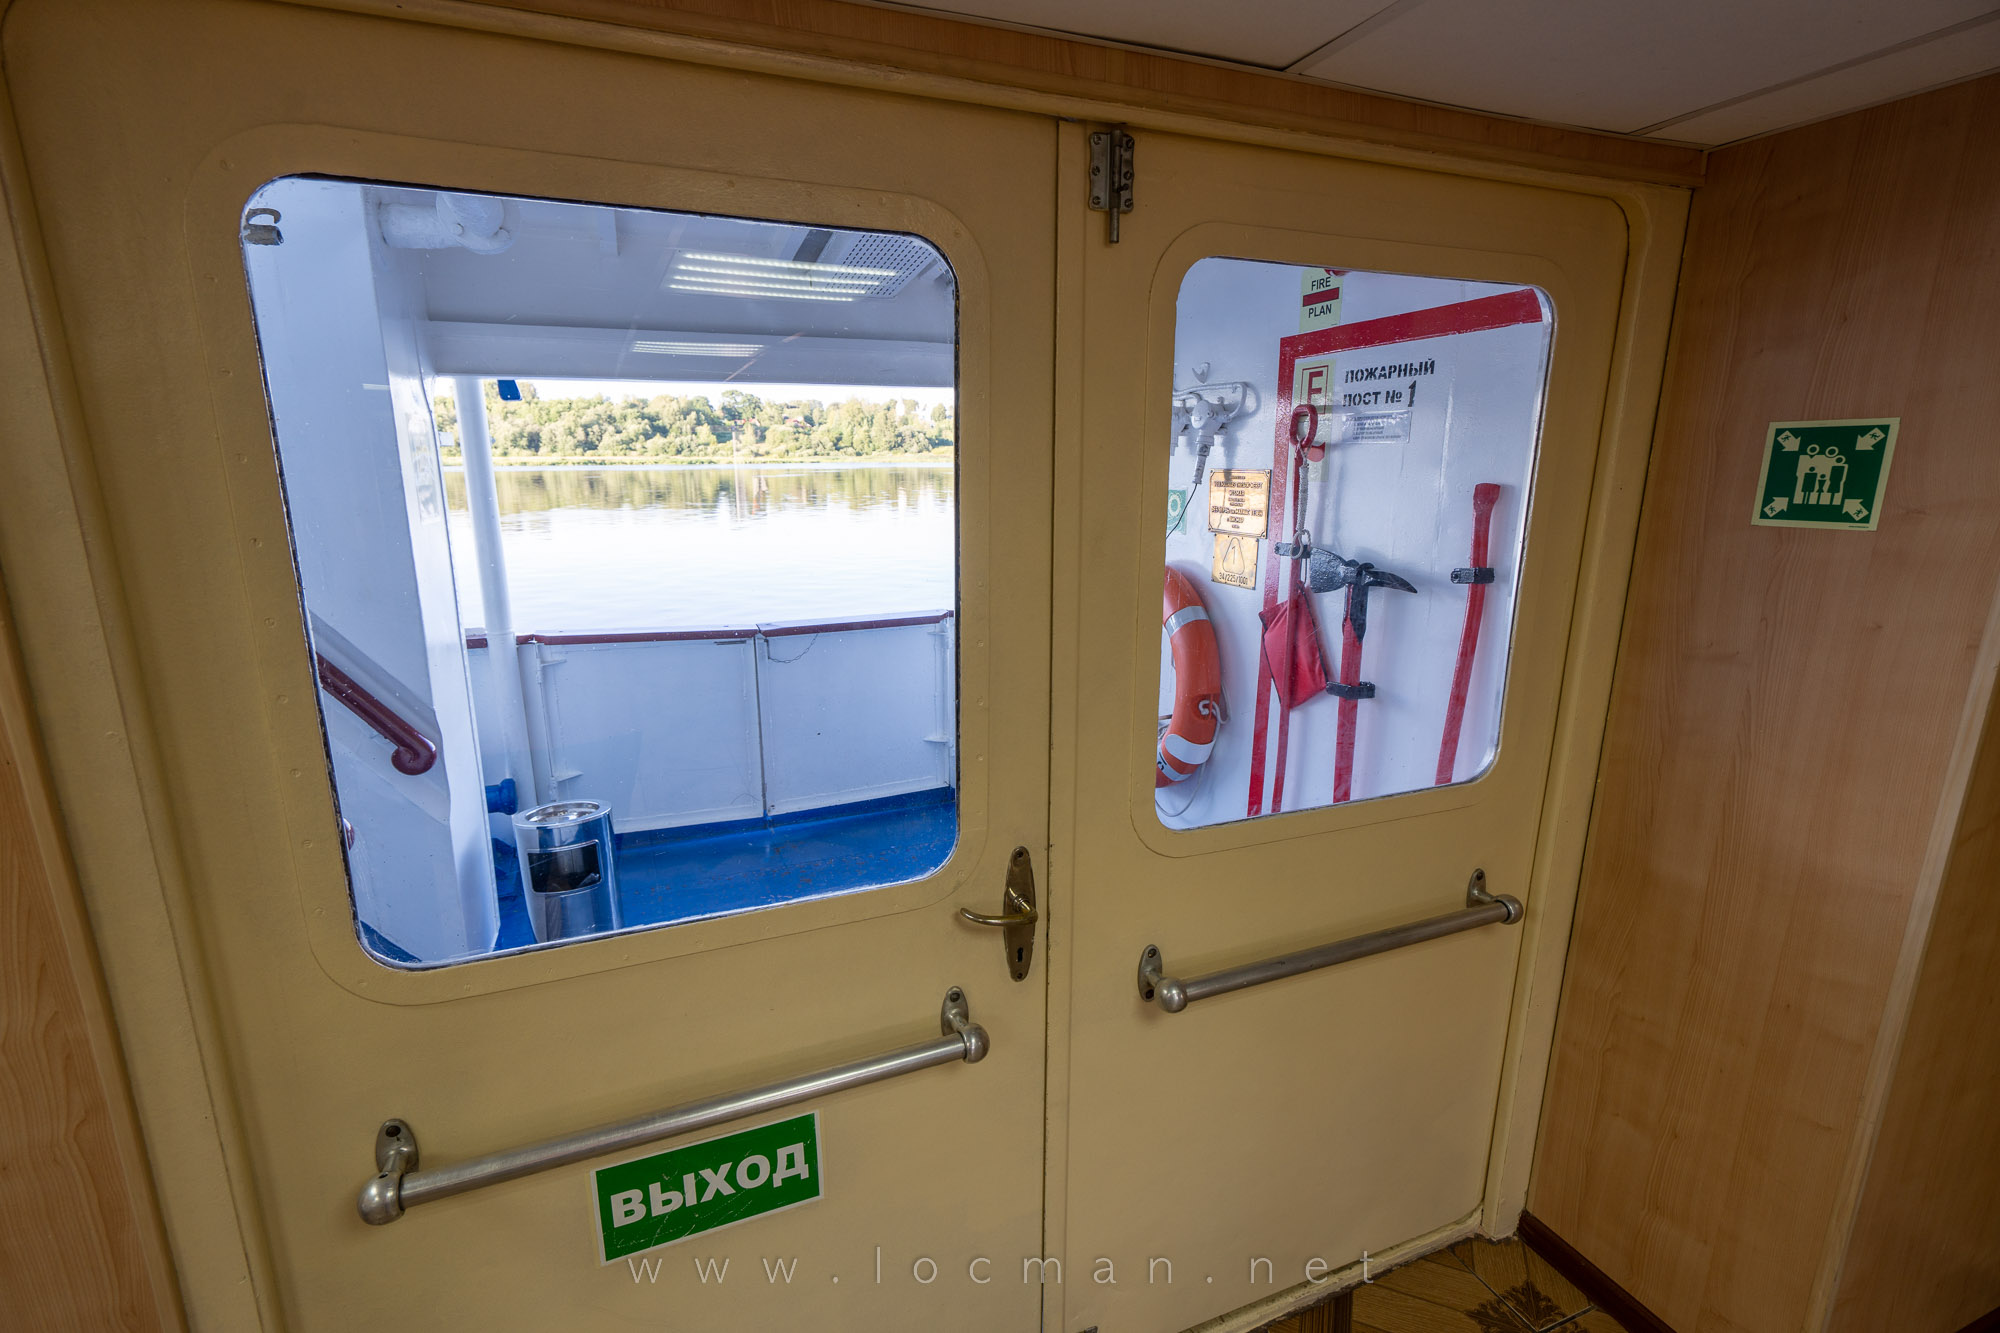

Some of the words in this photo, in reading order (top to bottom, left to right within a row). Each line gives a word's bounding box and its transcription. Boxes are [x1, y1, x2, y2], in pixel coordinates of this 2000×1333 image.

[1311, 276, 1331, 291] FIRE
[1308, 303, 1332, 318] PLAN
[1344, 358, 1436, 383] ПОЖАРНЫЙ
[1342, 391, 1381, 407] ПОСТ
[1407, 380, 1416, 407] 1
[610, 1142, 810, 1228] ВЫХОД
